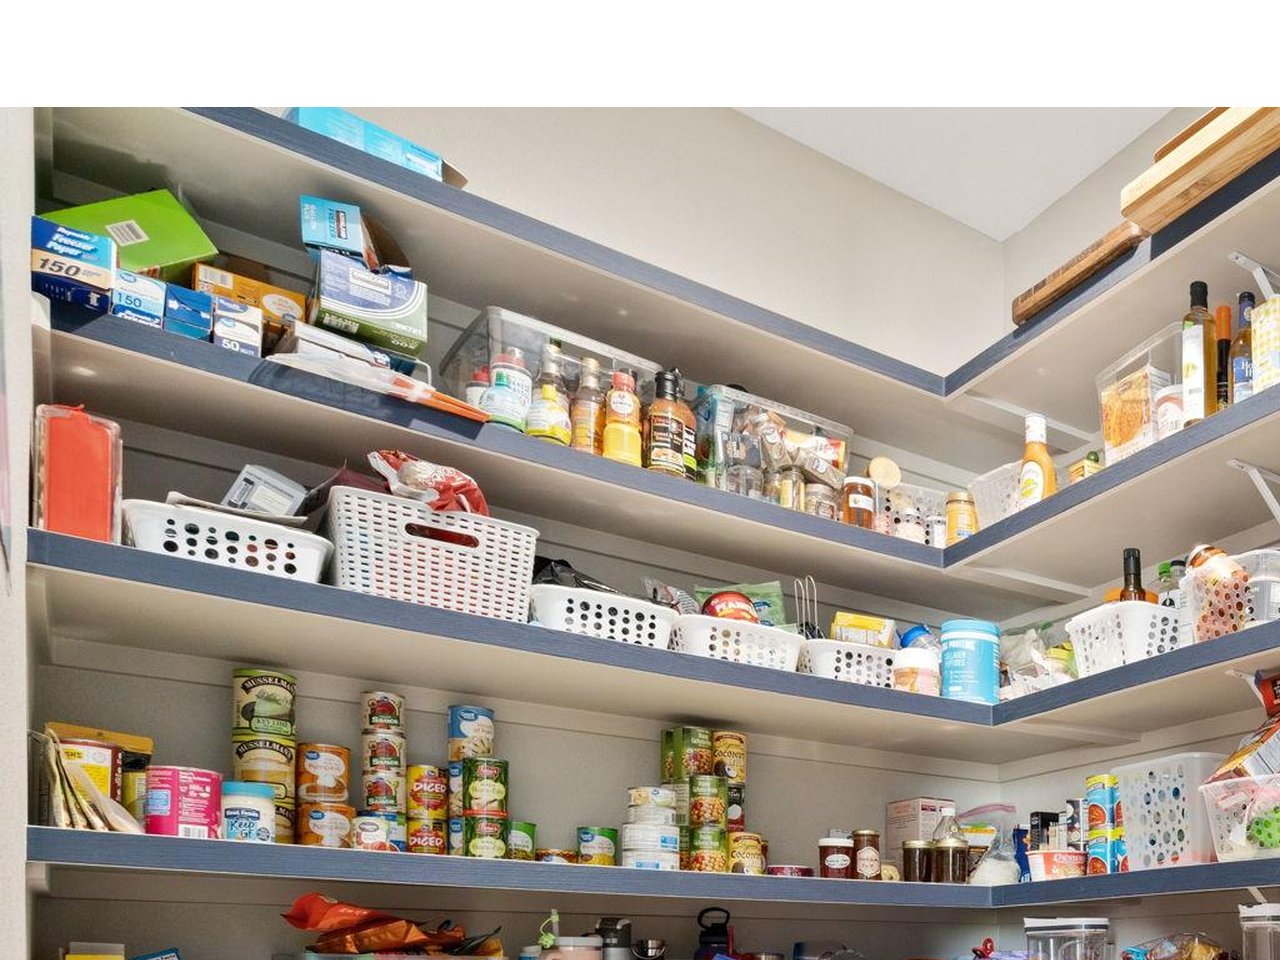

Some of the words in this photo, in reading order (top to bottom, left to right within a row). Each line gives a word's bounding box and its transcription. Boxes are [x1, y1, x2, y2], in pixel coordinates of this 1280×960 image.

[38, 256, 81, 277] 150
[117, 291, 142, 309] 150
[413, 782, 447, 793] DICED
[409, 837, 444, 846] DICED
